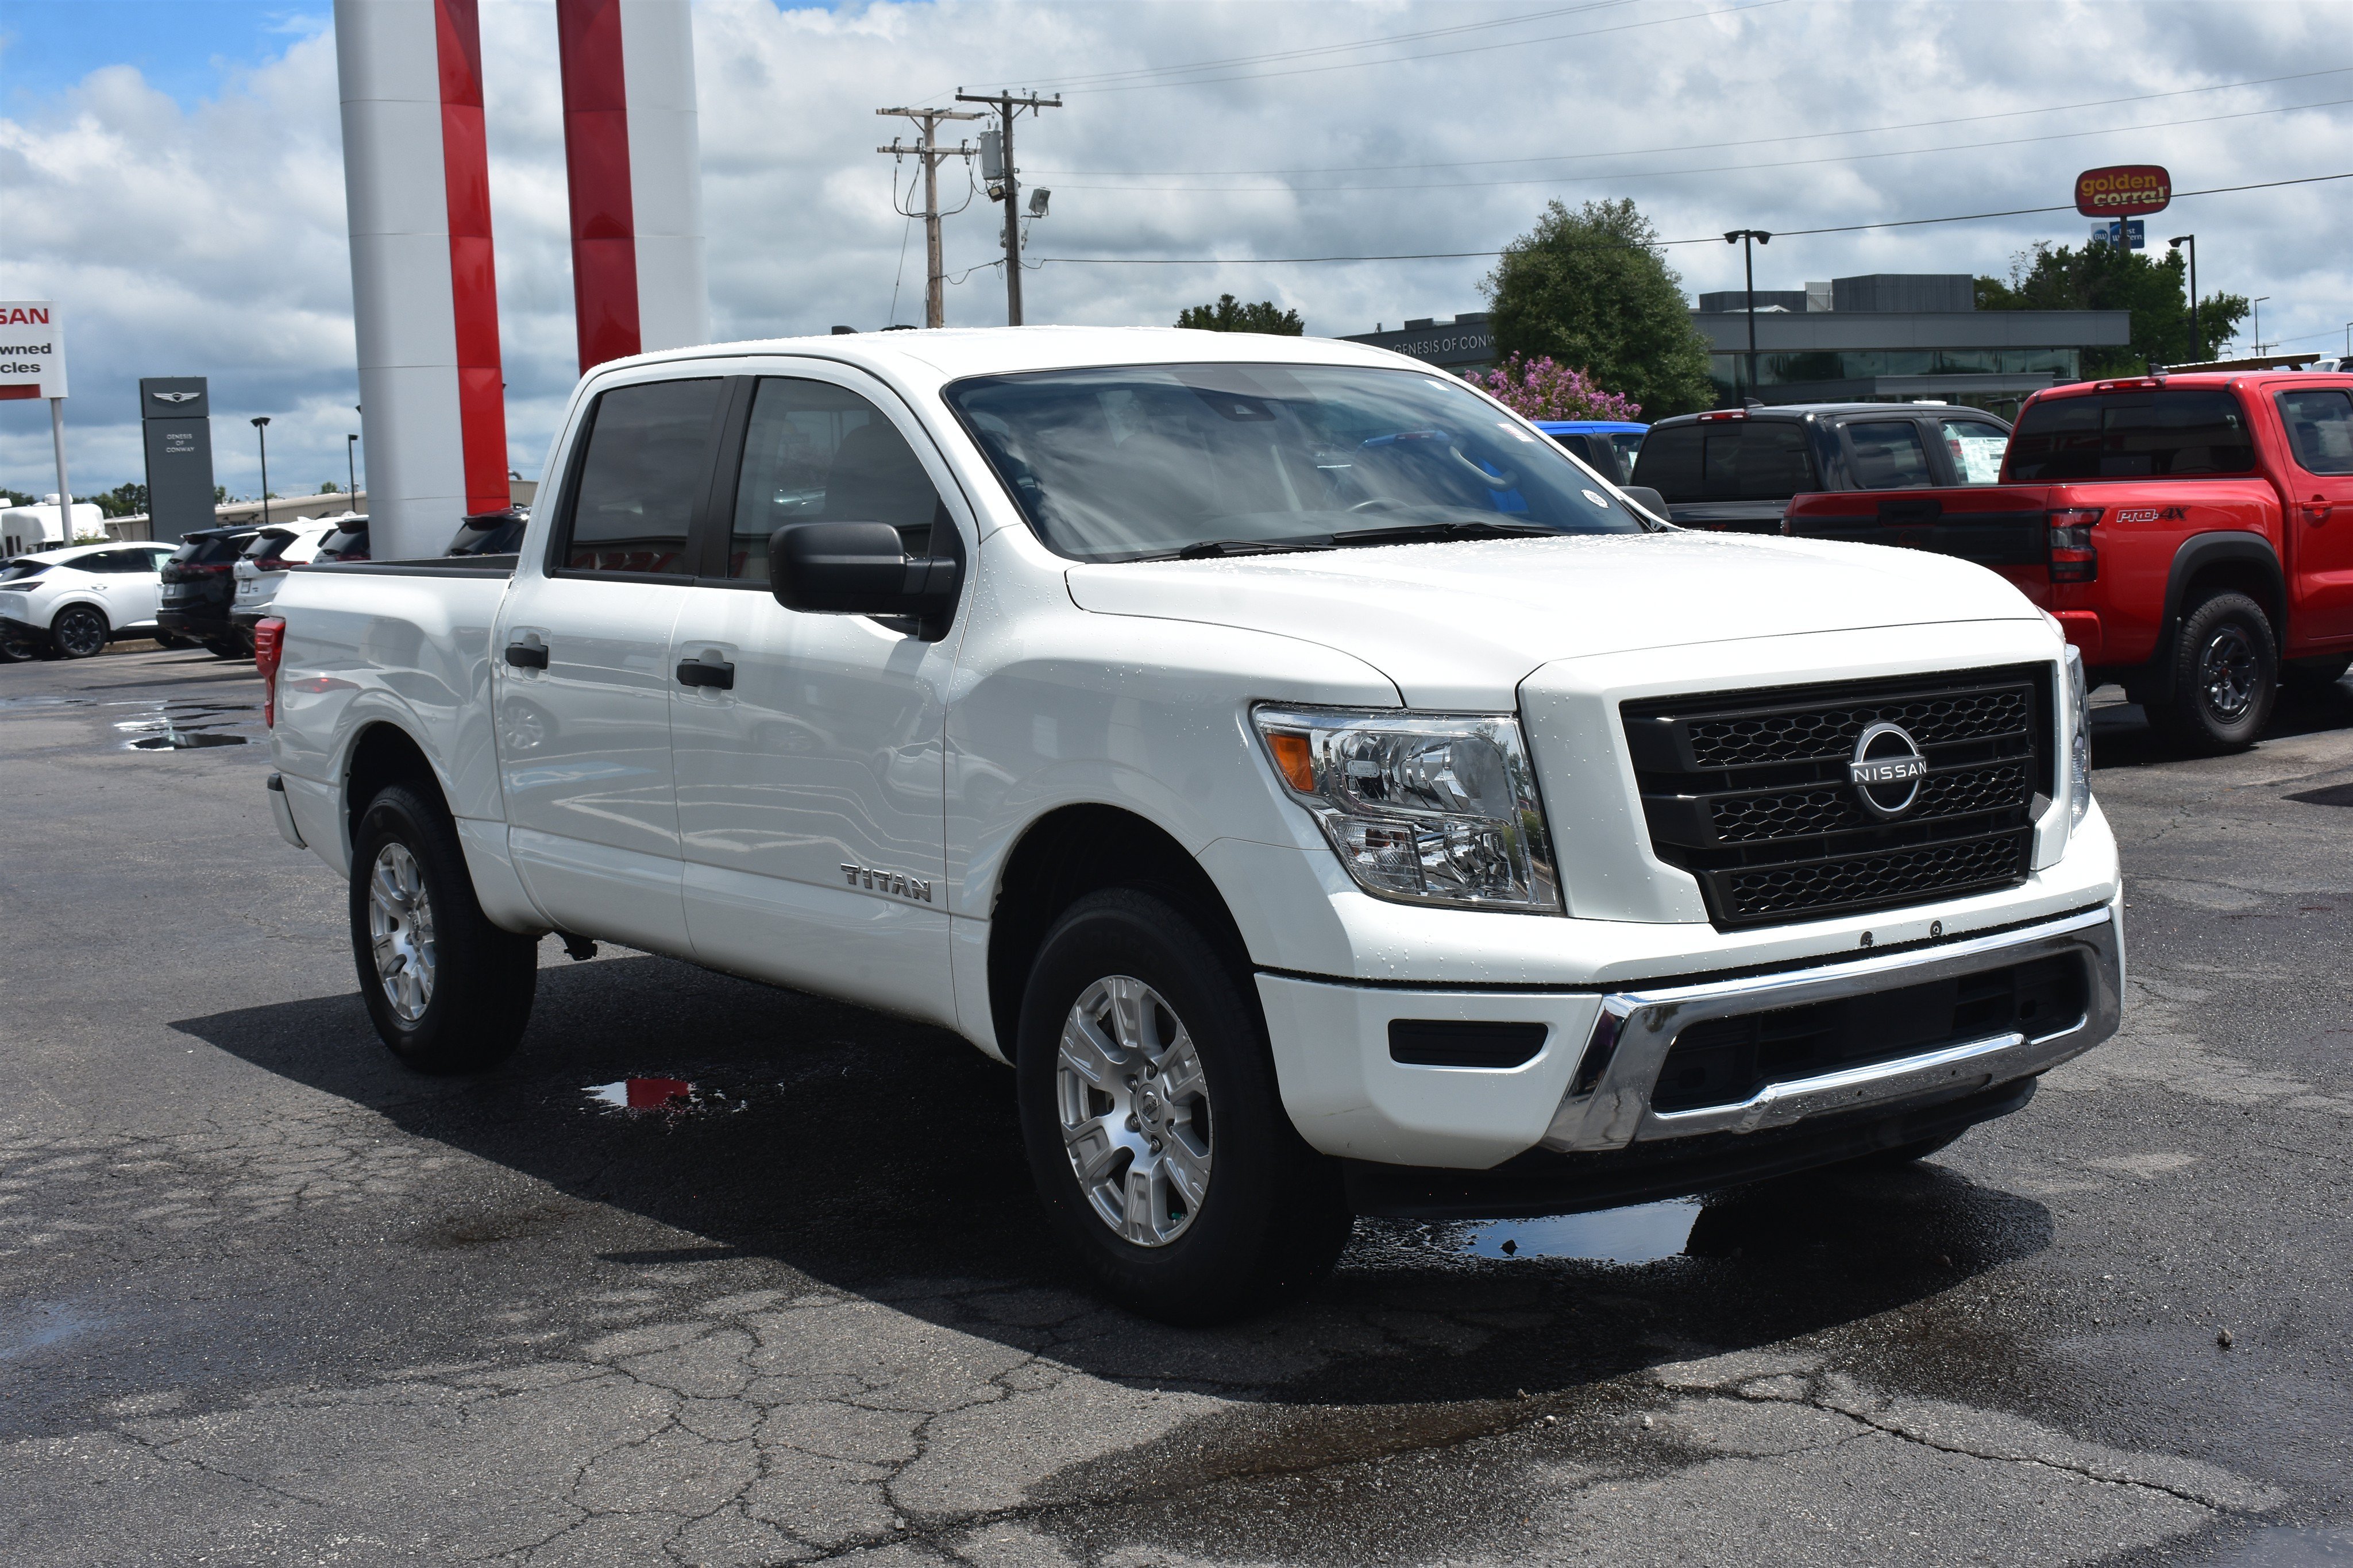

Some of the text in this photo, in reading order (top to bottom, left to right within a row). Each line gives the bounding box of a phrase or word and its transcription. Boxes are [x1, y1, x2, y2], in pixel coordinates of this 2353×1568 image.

[2081, 173, 2158, 196] golden
[2093, 187, 2165, 207] corral
[2094, 233, 2107, 241] BW
[1394, 339, 1440, 356] GENESIS
[1442, 338, 1457, 352] OF
[0, 361, 41, 374] cles
[1854, 761, 1927, 782] NISSAN
[840, 863, 932, 903] TITAN
